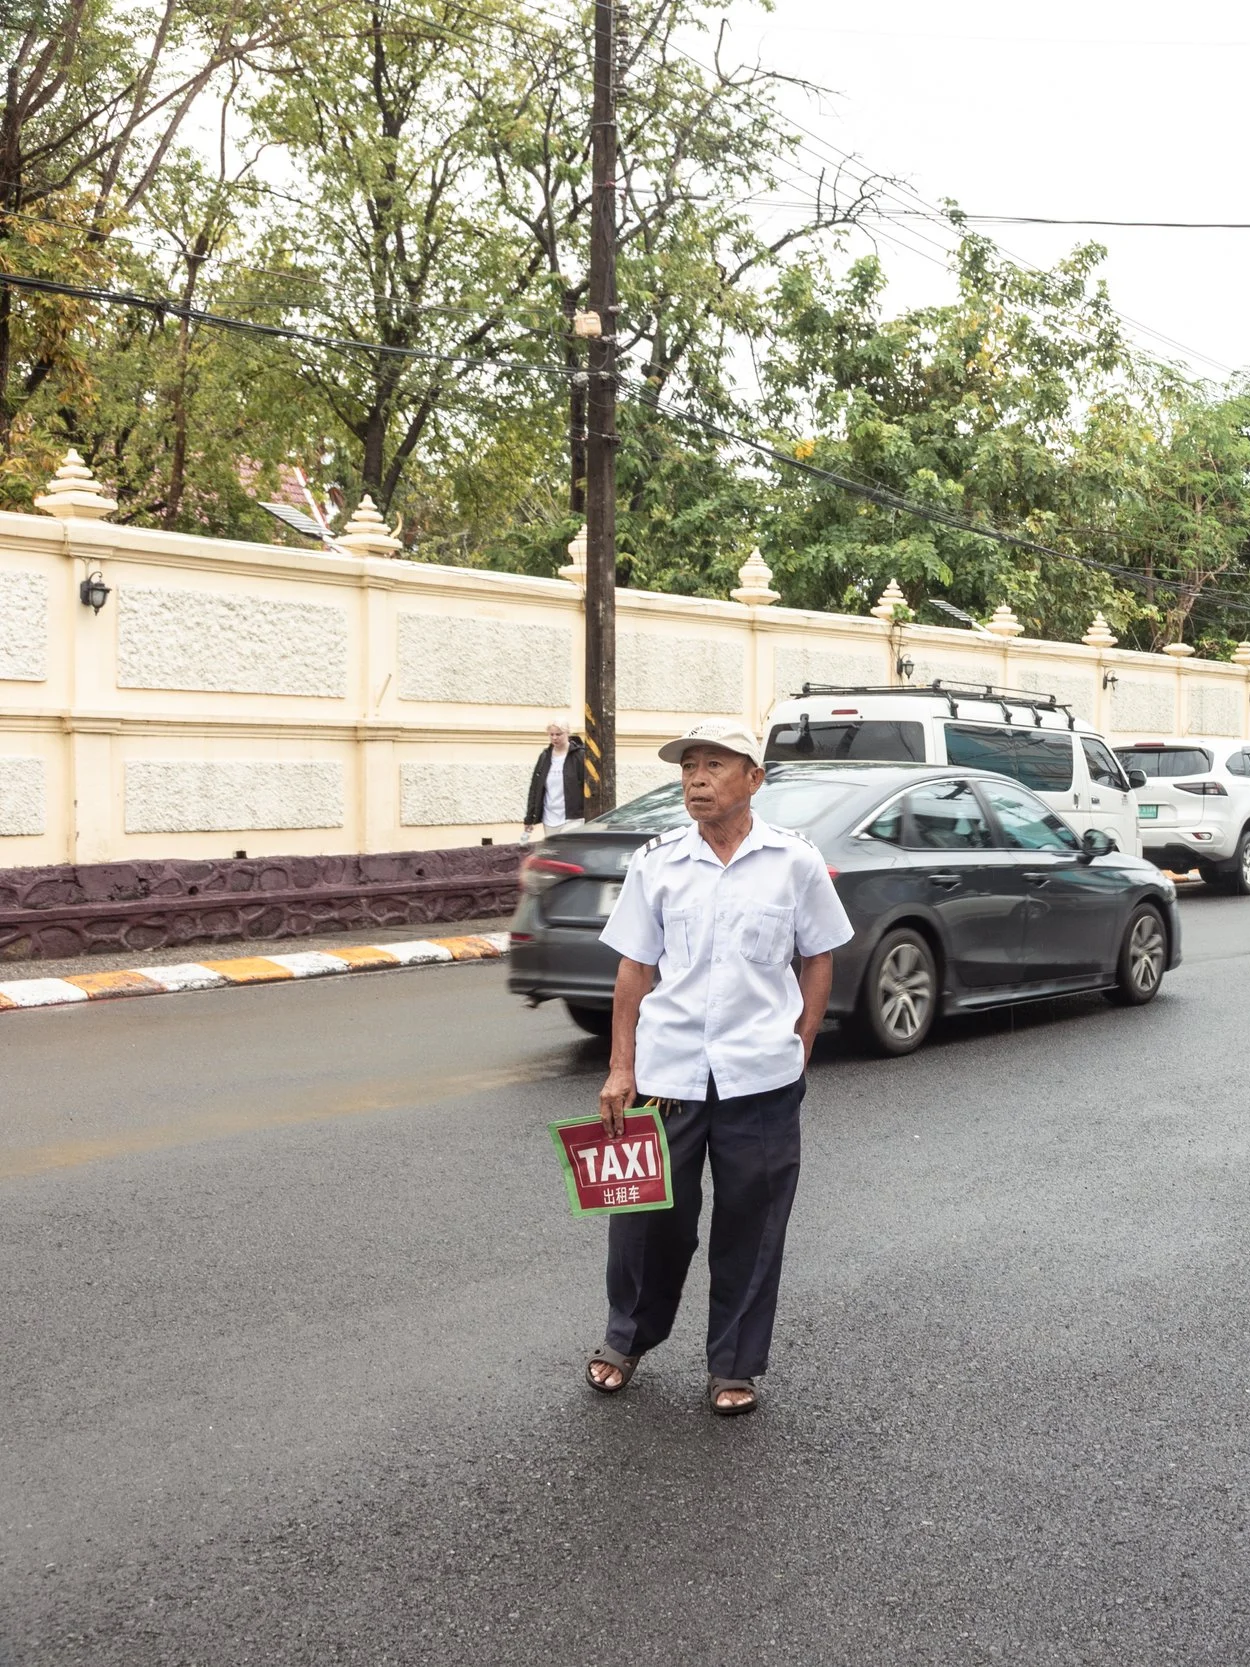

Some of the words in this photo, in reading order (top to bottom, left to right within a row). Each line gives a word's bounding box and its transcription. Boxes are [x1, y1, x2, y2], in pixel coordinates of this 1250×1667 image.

[577, 1140, 657, 1183] TAXI
[603, 1185, 641, 1205] 出租车
